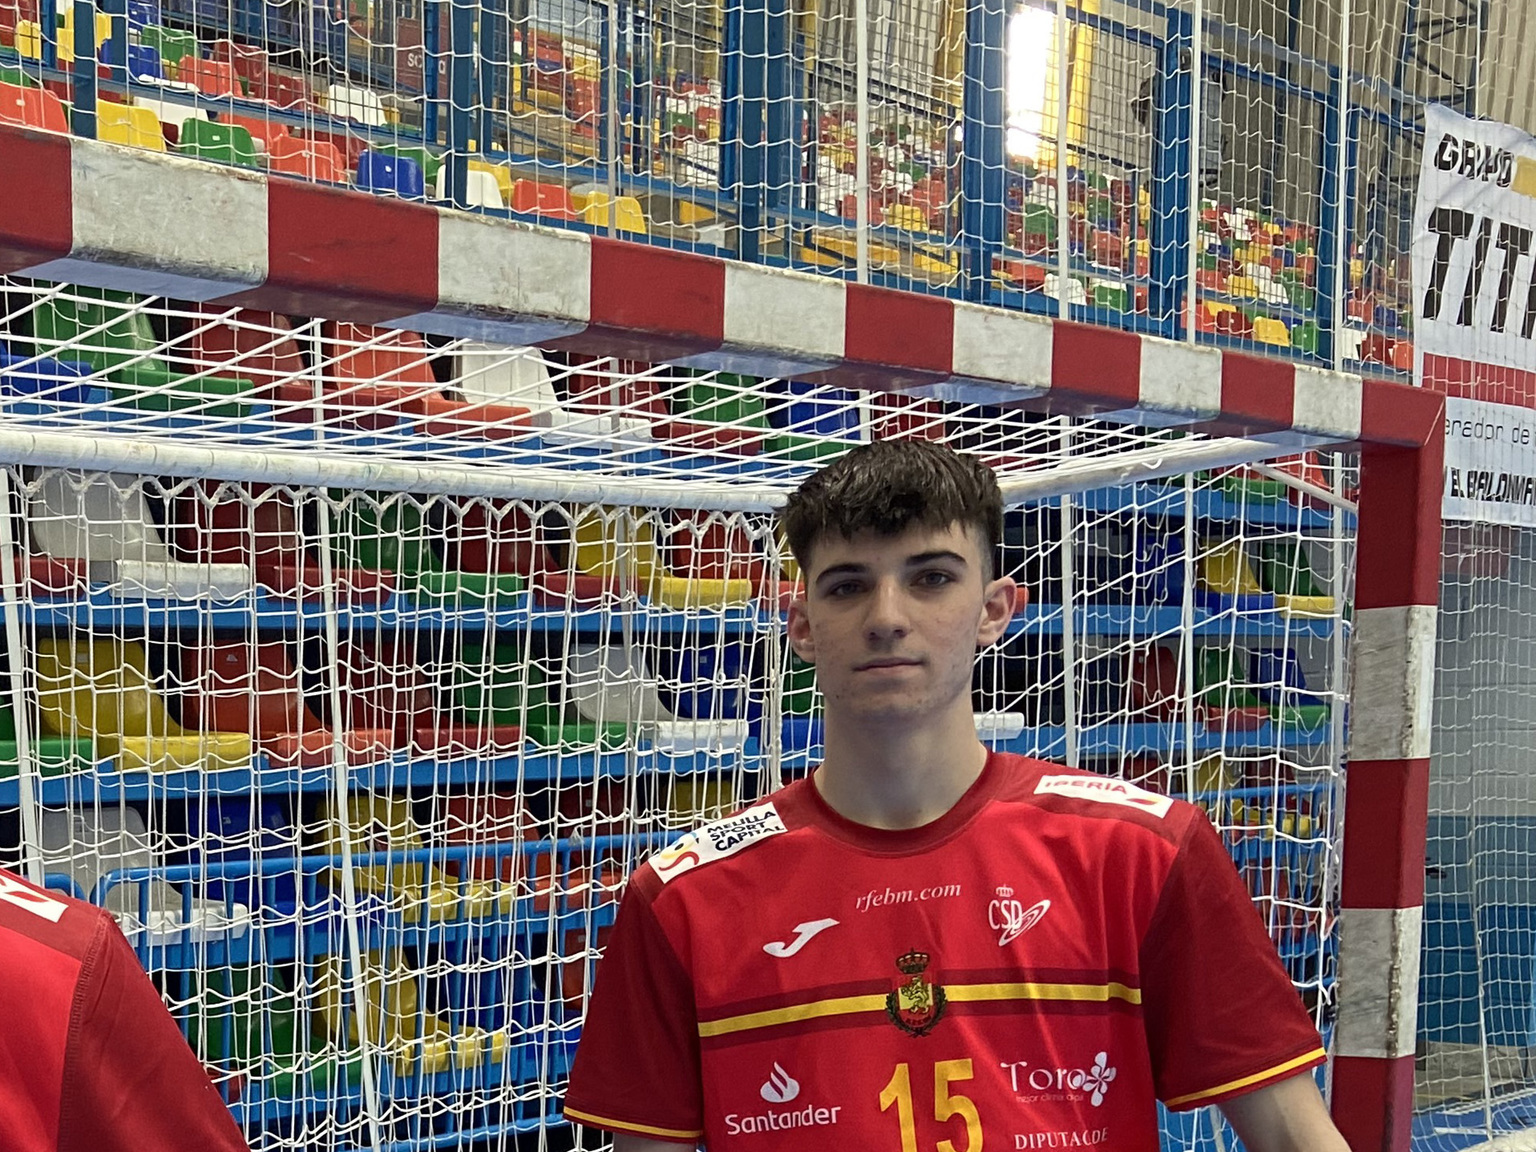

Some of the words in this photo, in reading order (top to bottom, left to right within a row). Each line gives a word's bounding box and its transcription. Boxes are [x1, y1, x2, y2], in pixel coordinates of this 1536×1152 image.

[1423, 206, 1536, 339] TIT
[1512, 422, 1530, 445] de
[1467, 469, 1536, 507] BALONMA
[707, 811, 775, 834] MELILLA
[710, 821, 765, 841] SPORT
[715, 825, 784, 851] CAPITAL
[855, 884, 962, 912] rfebm.com
[988, 900, 1022, 930] CSD
[725, 1104, 841, 1135] Santander
